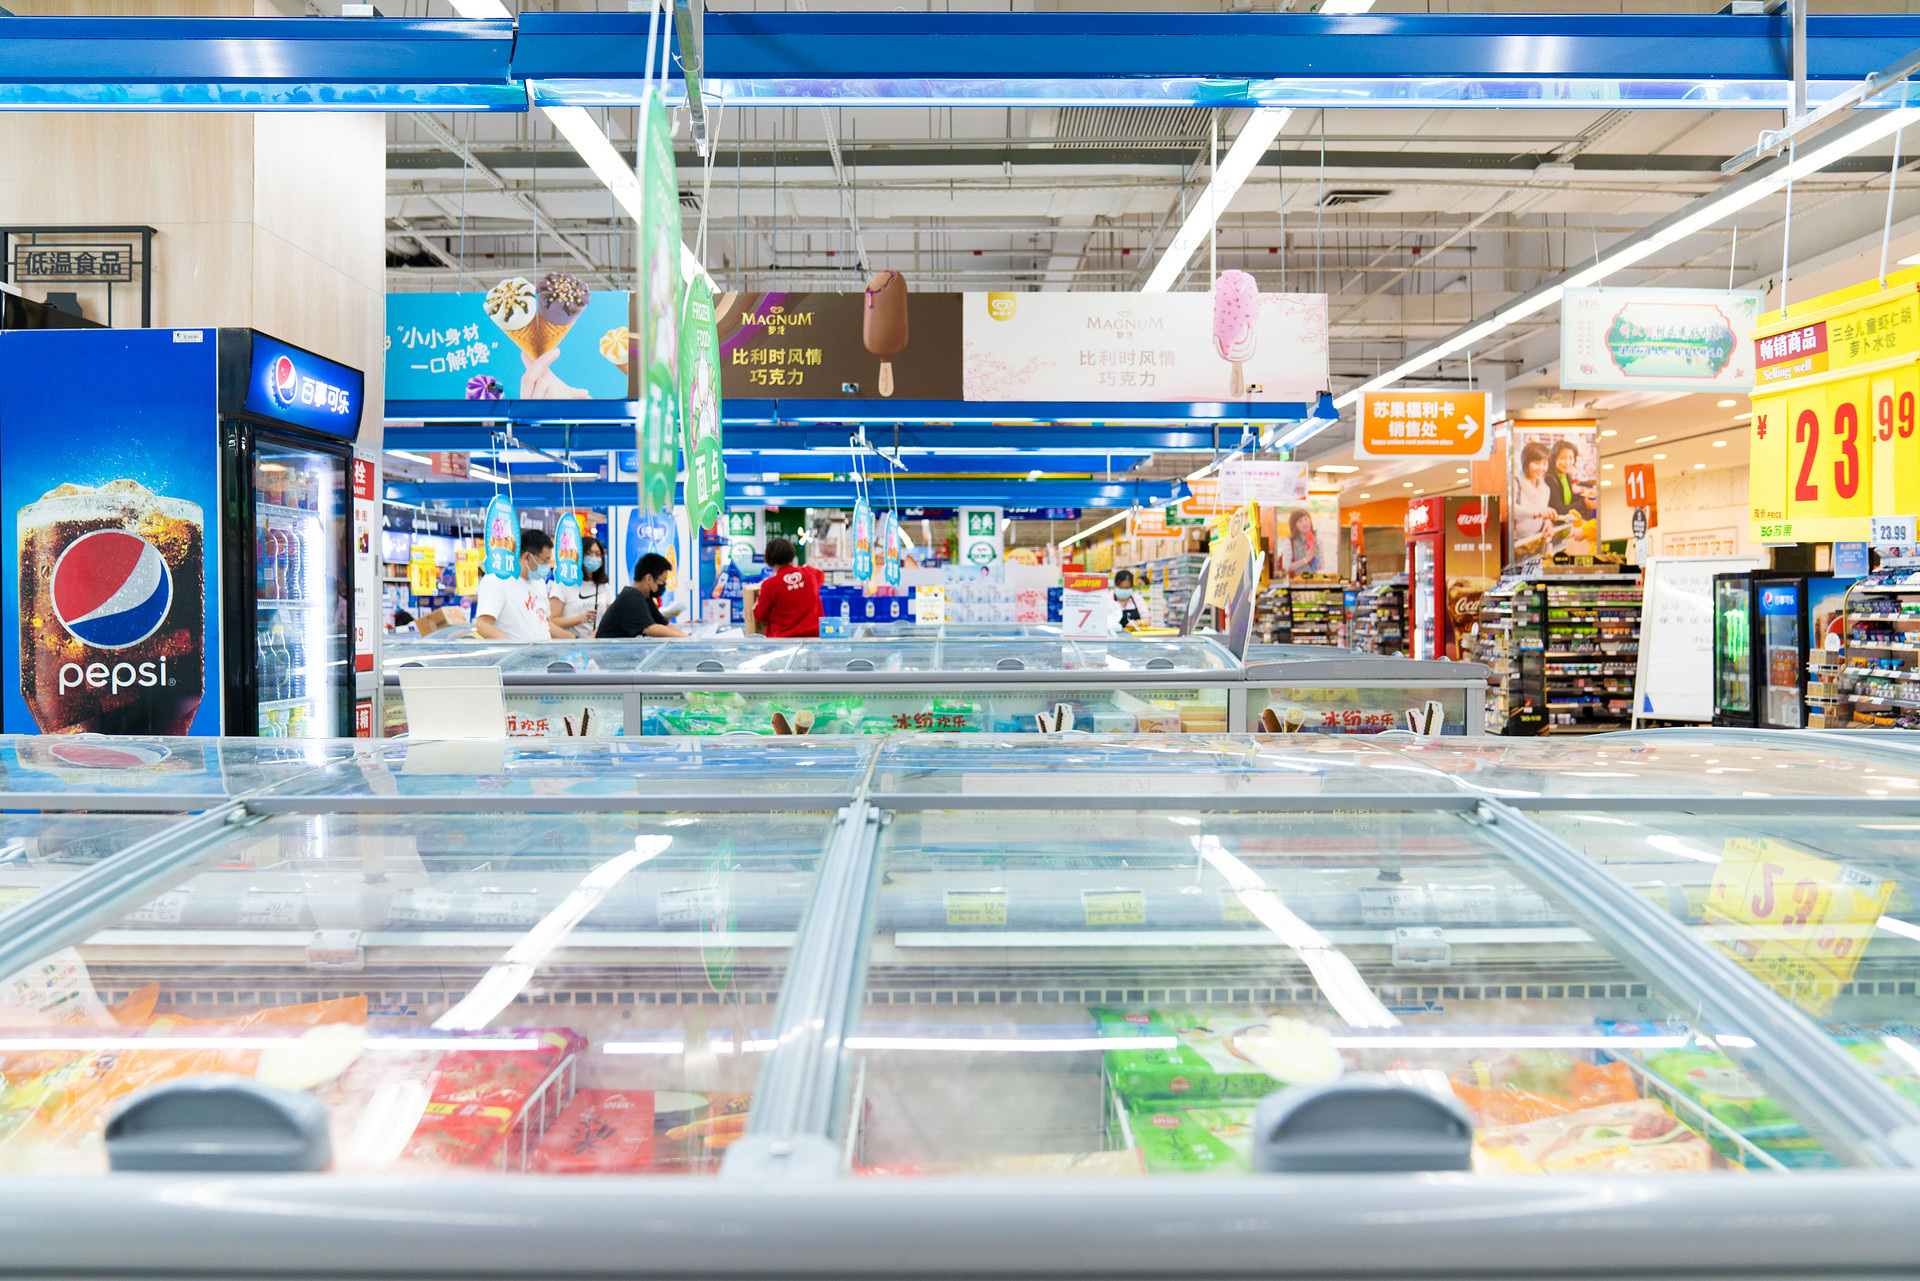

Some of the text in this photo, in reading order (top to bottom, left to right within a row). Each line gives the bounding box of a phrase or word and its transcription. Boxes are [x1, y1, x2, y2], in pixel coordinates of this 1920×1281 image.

[24, 250, 122, 276] 低温食品
[692, 301, 711, 323] FROZEN
[741, 312, 814, 326] MAGNUM
[1086, 316, 1165, 330] MAGNUM
[1832, 307, 1912, 343] 三全儿童虾仁胡
[1760, 326, 1817, 361] 畅销商品
[1849, 333, 1896, 358] 萝卜水饺
[732, 348, 823, 366] 比利时风情
[1080, 350, 1176, 367] 比利时风情
[750, 368, 805, 386] 巧克力
[1763, 358, 1812, 381] Selling well
[1099, 371, 1156, 387] 巧克力
[301, 376, 350, 414] 百事可乐
[1373, 401, 1455, 418] 苏果福利卡
[1388, 420, 1438, 437] 销售处
[1628, 471, 1645, 500] 11
[730, 513, 753, 530] 金典
[969, 513, 994, 530] 金典
[1767, 511, 1782, 519] PRICE
[1880, 525, 1906, 541] 23.99
[59, 655, 168, 695] pepsi
[892, 712, 966, 729] 冰纷欢乐
[1320, 710, 1394, 727] 冰纷欢乐
